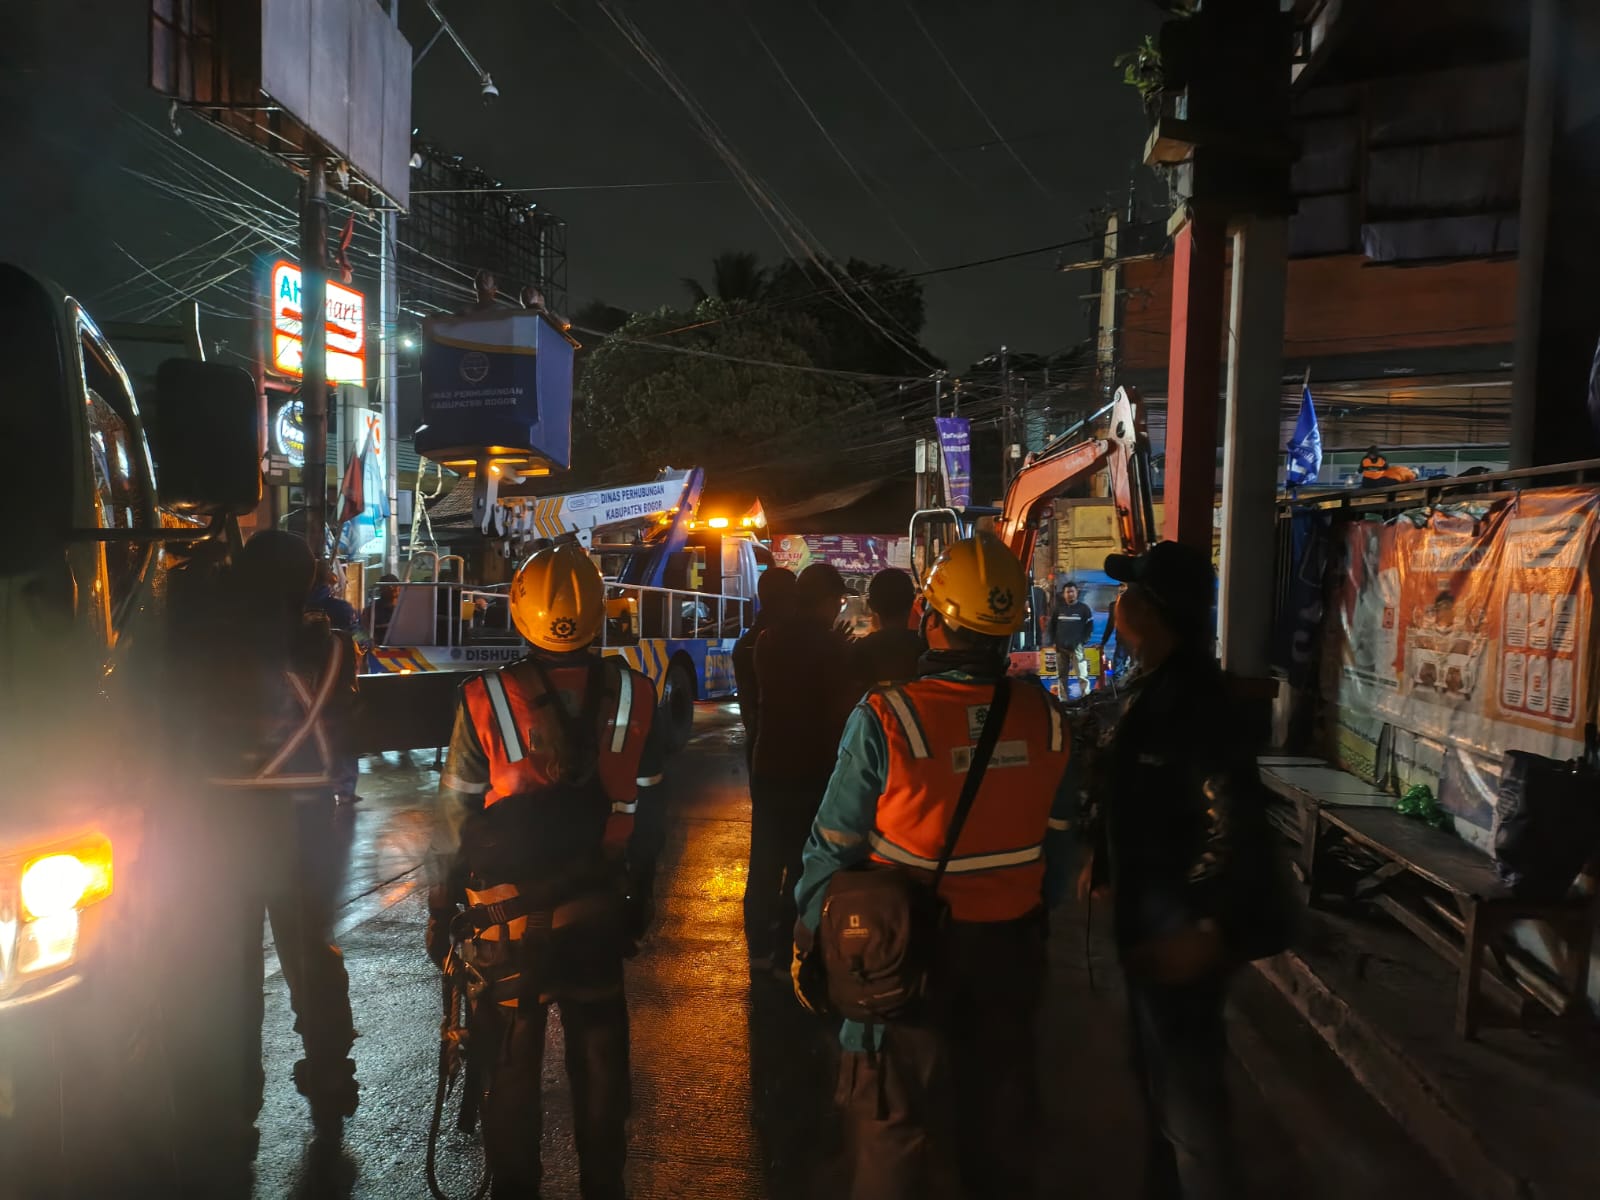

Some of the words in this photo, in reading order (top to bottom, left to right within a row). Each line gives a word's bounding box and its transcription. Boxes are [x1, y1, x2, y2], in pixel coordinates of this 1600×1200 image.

[484, 397, 517, 406] BOGOR
[600, 491, 621, 504] DINAS
[621, 485, 665, 501] PERHUBUNGAN
[606, 504, 642, 520] KABUPATEN
[643, 500, 663, 513] BOGOR
[465, 649, 520, 661] DISHUB
